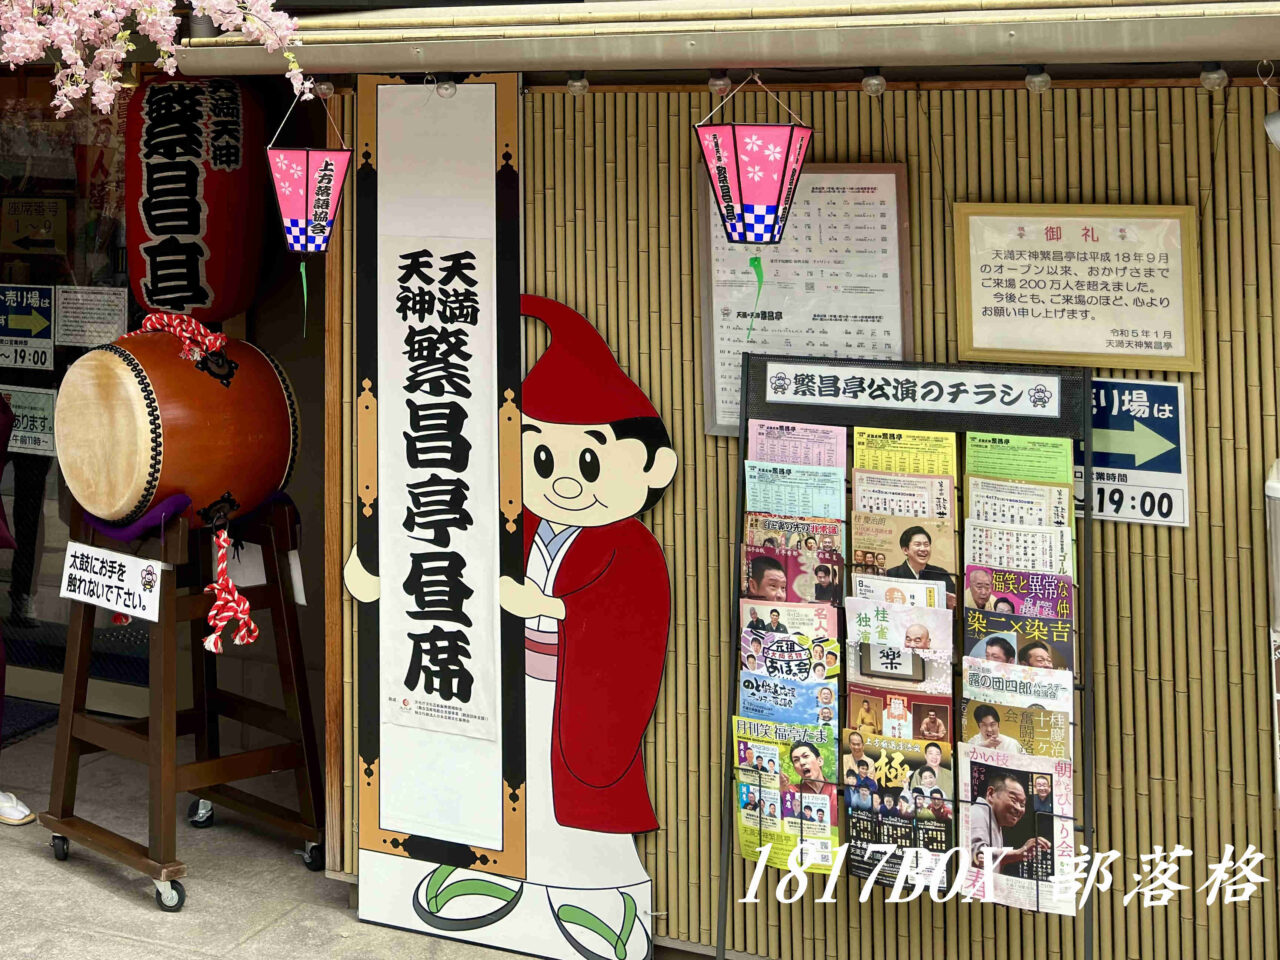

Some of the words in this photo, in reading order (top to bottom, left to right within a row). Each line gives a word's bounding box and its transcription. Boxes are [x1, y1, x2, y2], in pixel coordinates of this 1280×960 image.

[142, 84, 216, 311] 繁昌亭
[309, 159, 335, 236] 上方落語協会
[980, 264, 1170, 280] のオープン以来、おかげさまで
[981, 305, 1096, 321] お願い申し上げます。
[1106, 340, 1173, 351] 天満天神繁昌亭
[792, 372, 1024, 407] 繁昌亭公演のチラシ
[401, 325, 475, 706] 繁昌亭昼席
[69, 550, 127, 583] 太鼓にお手を
[66, 573, 148, 612] 触れないで下さい。
[873, 606, 890, 646] 桂雀
[967, 611, 1071, 643] 染二×染吉
[736, 719, 827, 743] 月刊笑福亭たま
